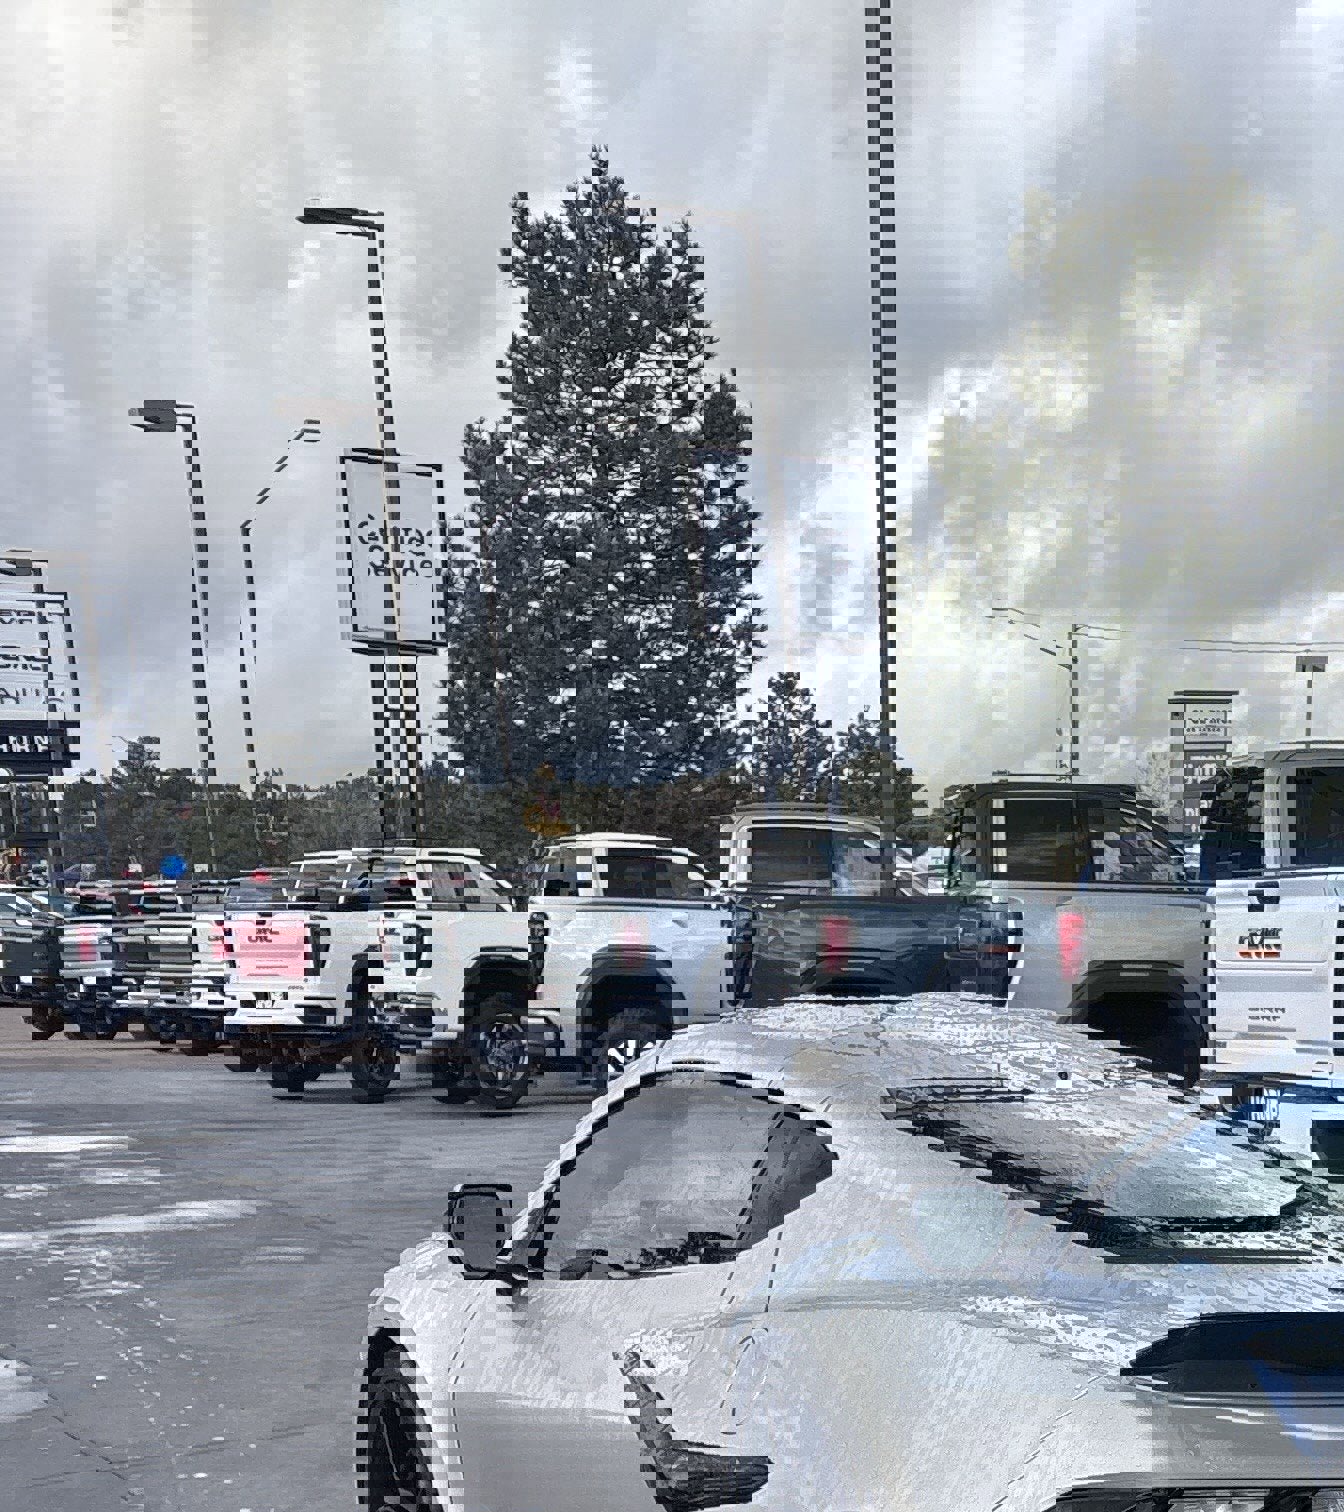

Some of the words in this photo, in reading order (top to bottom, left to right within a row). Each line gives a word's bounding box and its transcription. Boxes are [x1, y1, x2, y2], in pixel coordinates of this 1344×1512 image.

[724, 512, 858, 549] Cerified
[736, 544, 852, 578] Sevice
[0, 645, 90, 662] GMC
[8, 730, 100, 749] HORNE
